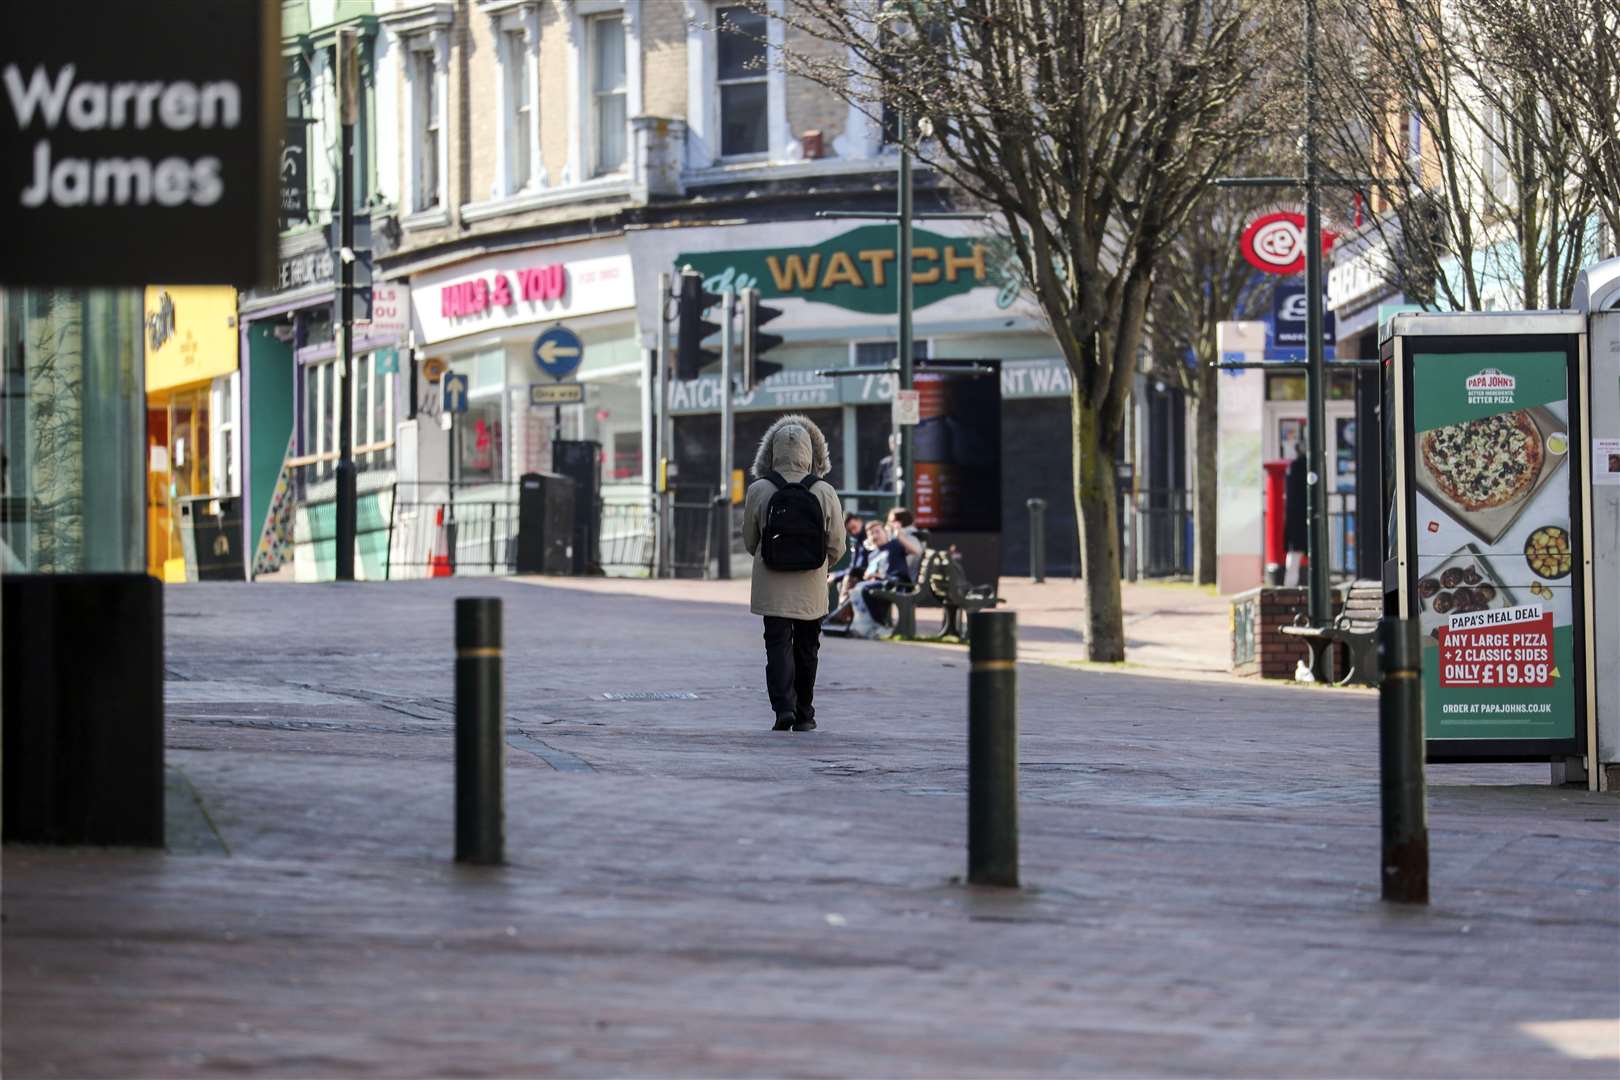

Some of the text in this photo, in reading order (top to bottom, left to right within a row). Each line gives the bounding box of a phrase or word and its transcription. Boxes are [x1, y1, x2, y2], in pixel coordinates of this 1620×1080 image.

[3, 62, 241, 130] Warren
[20, 140, 223, 207] James
[1253, 220, 1308, 265] Ce
[765, 244, 988, 292] WATCH
[441, 277, 489, 318] NAILS
[493, 271, 512, 307] &
[516, 263, 566, 301] YOU
[375, 306, 396, 318] OU
[1468, 377, 1487, 387] PAPA
[1468, 396, 1493, 404] BETTER
[1451, 607, 1540, 629] PAPA'S MEAL DEAL
[1444, 634, 1548, 647] ANY LARGE PIZZA
[1445, 649, 1548, 662] + 2 CLASSIC SIDES
[1445, 664, 1480, 679] ONLY
[1442, 703, 1552, 713] ORDER AT PAPAJOHNS.CO.UK
